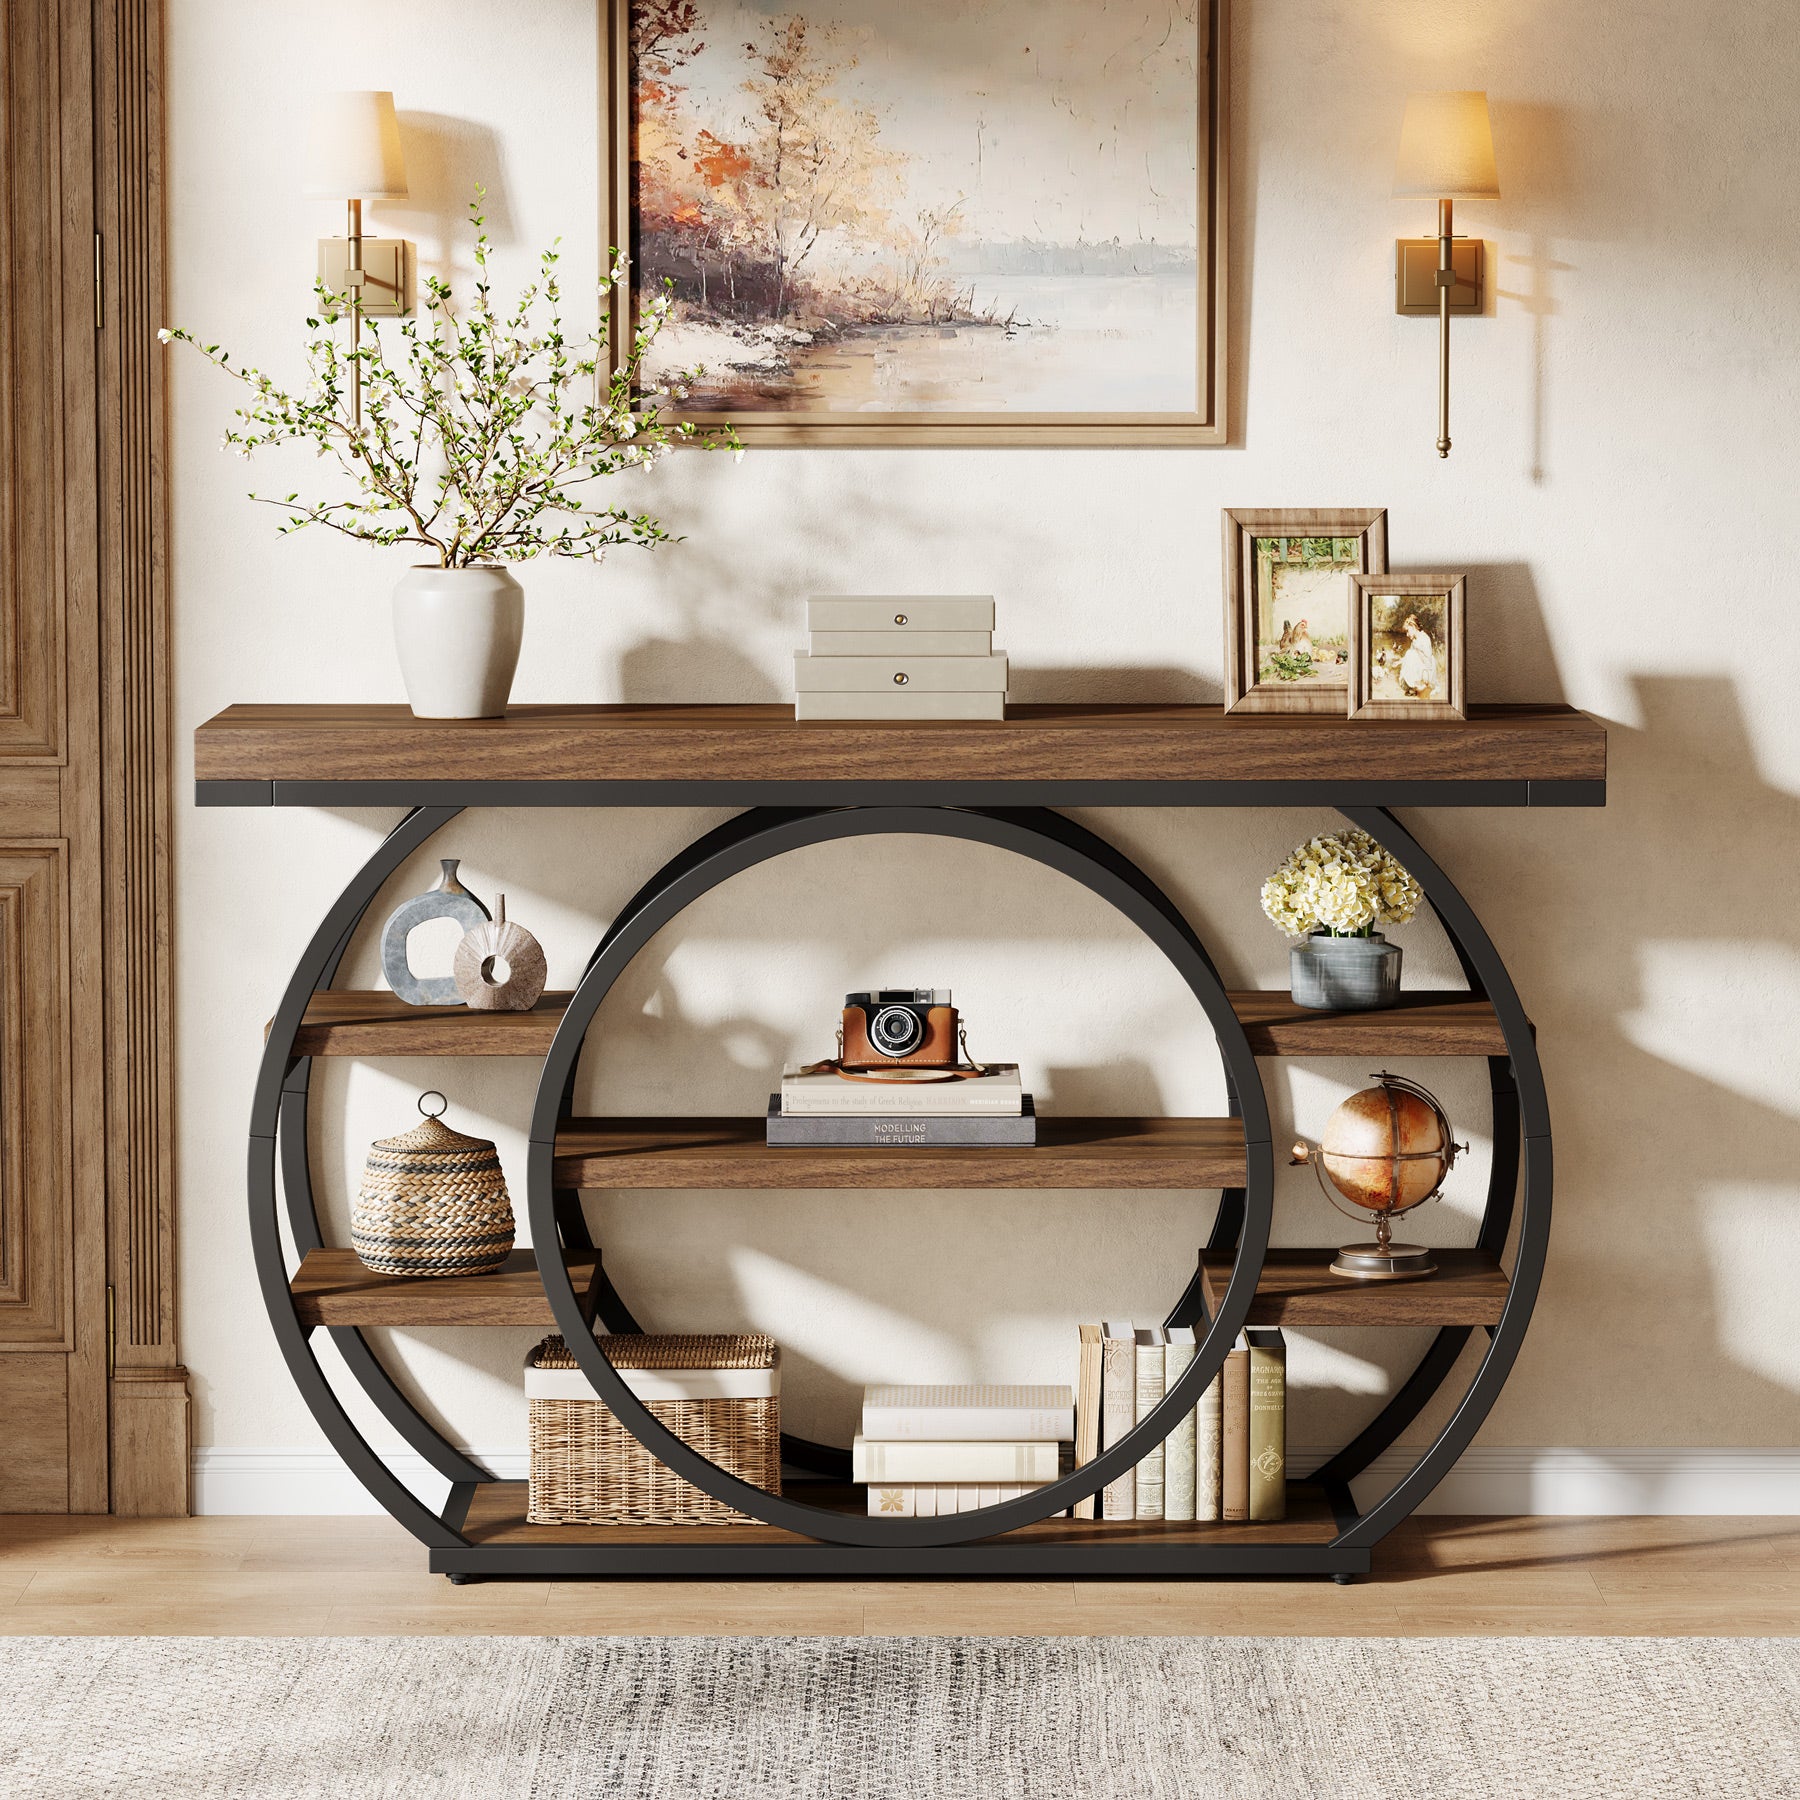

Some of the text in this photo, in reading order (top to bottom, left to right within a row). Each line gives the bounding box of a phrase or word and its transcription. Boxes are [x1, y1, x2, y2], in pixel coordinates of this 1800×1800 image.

[840, 1095, 850, 1105] the
[851, 1095, 868, 1108] study
[869, 1095, 877, 1105] of
[878, 1095, 896, 1105] Greek
[874, 1123, 926, 1133] MODELLING
[875, 1135, 926, 1143] THE FUTURE
